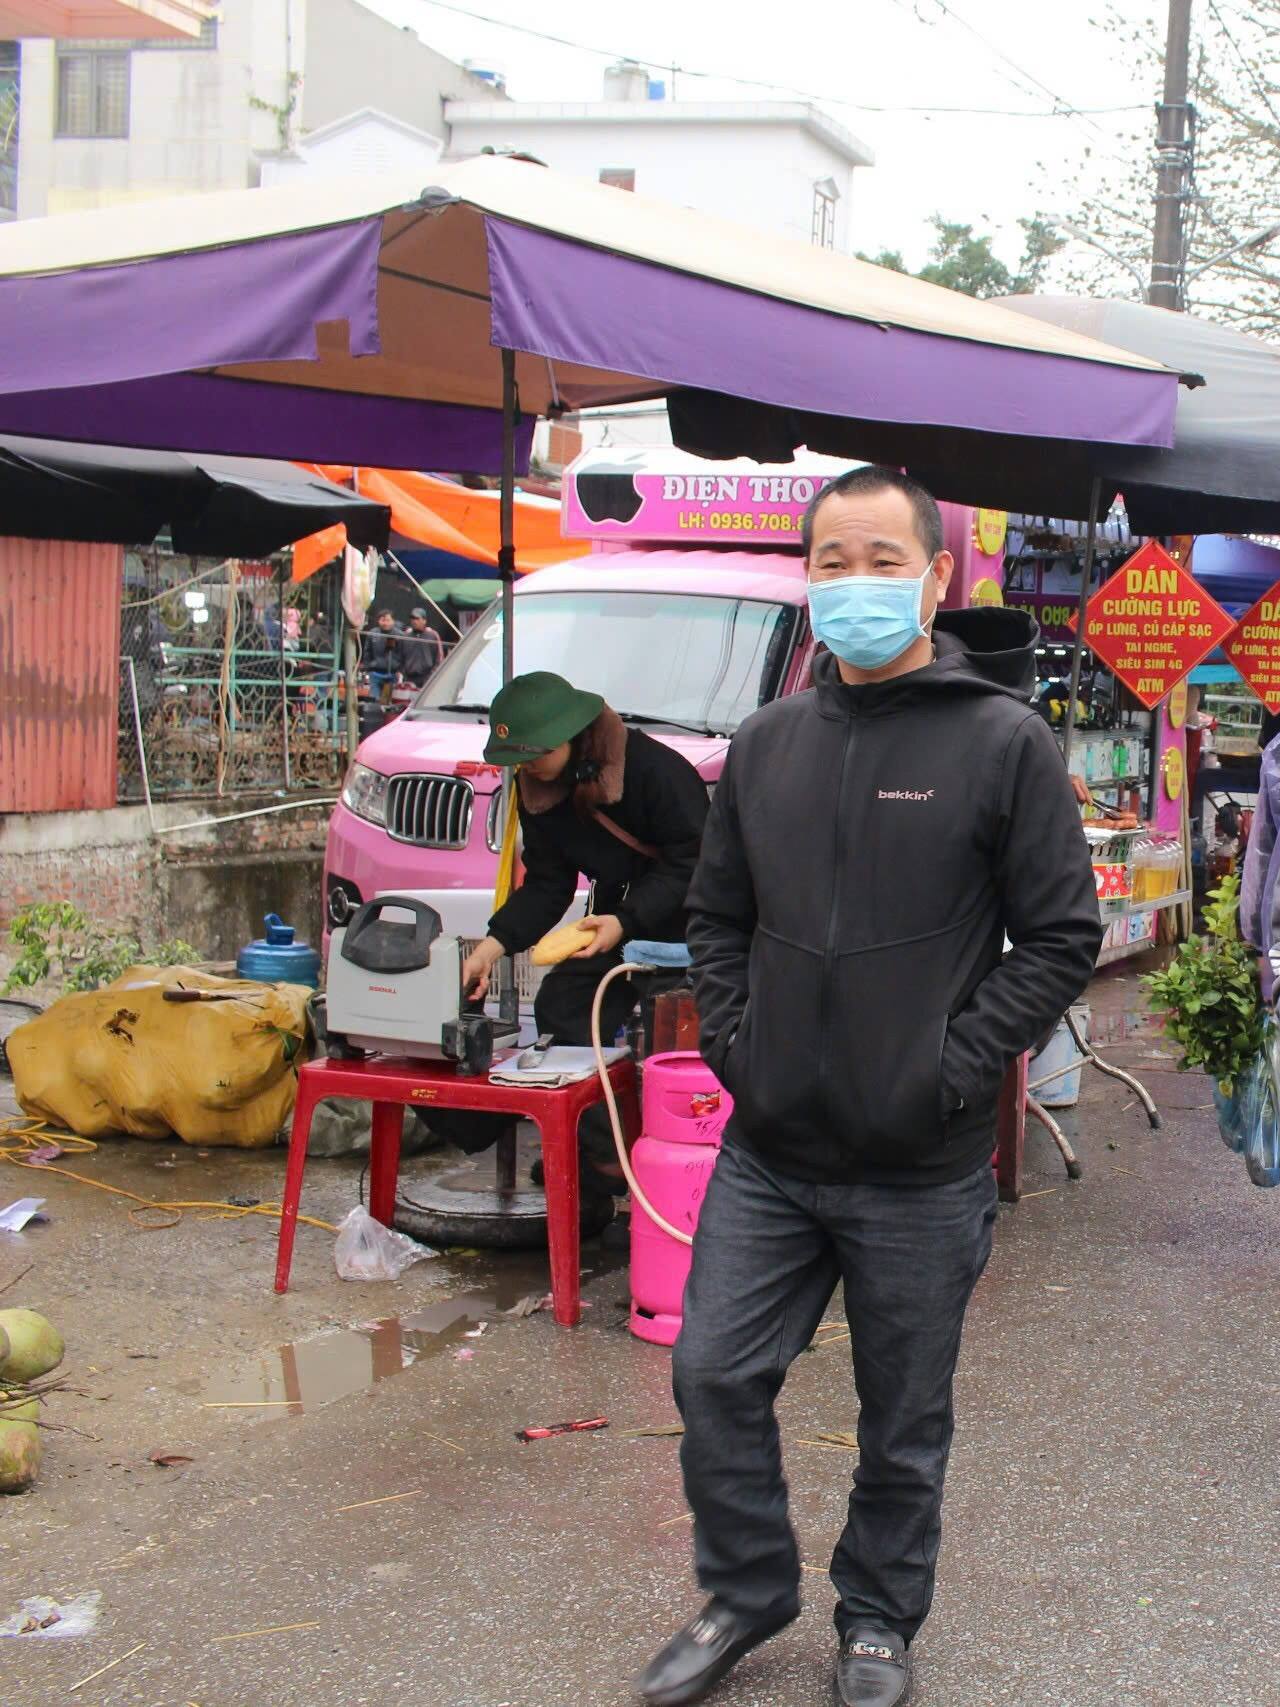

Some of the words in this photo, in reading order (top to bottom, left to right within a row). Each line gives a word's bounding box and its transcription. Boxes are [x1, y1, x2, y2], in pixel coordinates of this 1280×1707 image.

[663, 475, 740, 508] ĐIỆN
[748, 477, 830, 503] THO
[678, 511, 705, 529] LH:
[1126, 564, 1178, 595] DÁN
[1102, 596, 1163, 617] CƯỜNG
[1167, 598, 1201, 620] LỰC
[1106, 622, 1141, 637] LƯNG,
[1188, 623, 1212, 640] SẠC
[1125, 642, 1142, 653] TAI
[1144, 642, 1177, 654] NGHE,
[1116, 656, 1141, 670] SIÊU
[1144, 659, 1165, 670] SIM
[1168, 659, 1183, 670] 4G
[1136, 677, 1165, 693] ATM
[878, 790, 928, 801] bekkin
